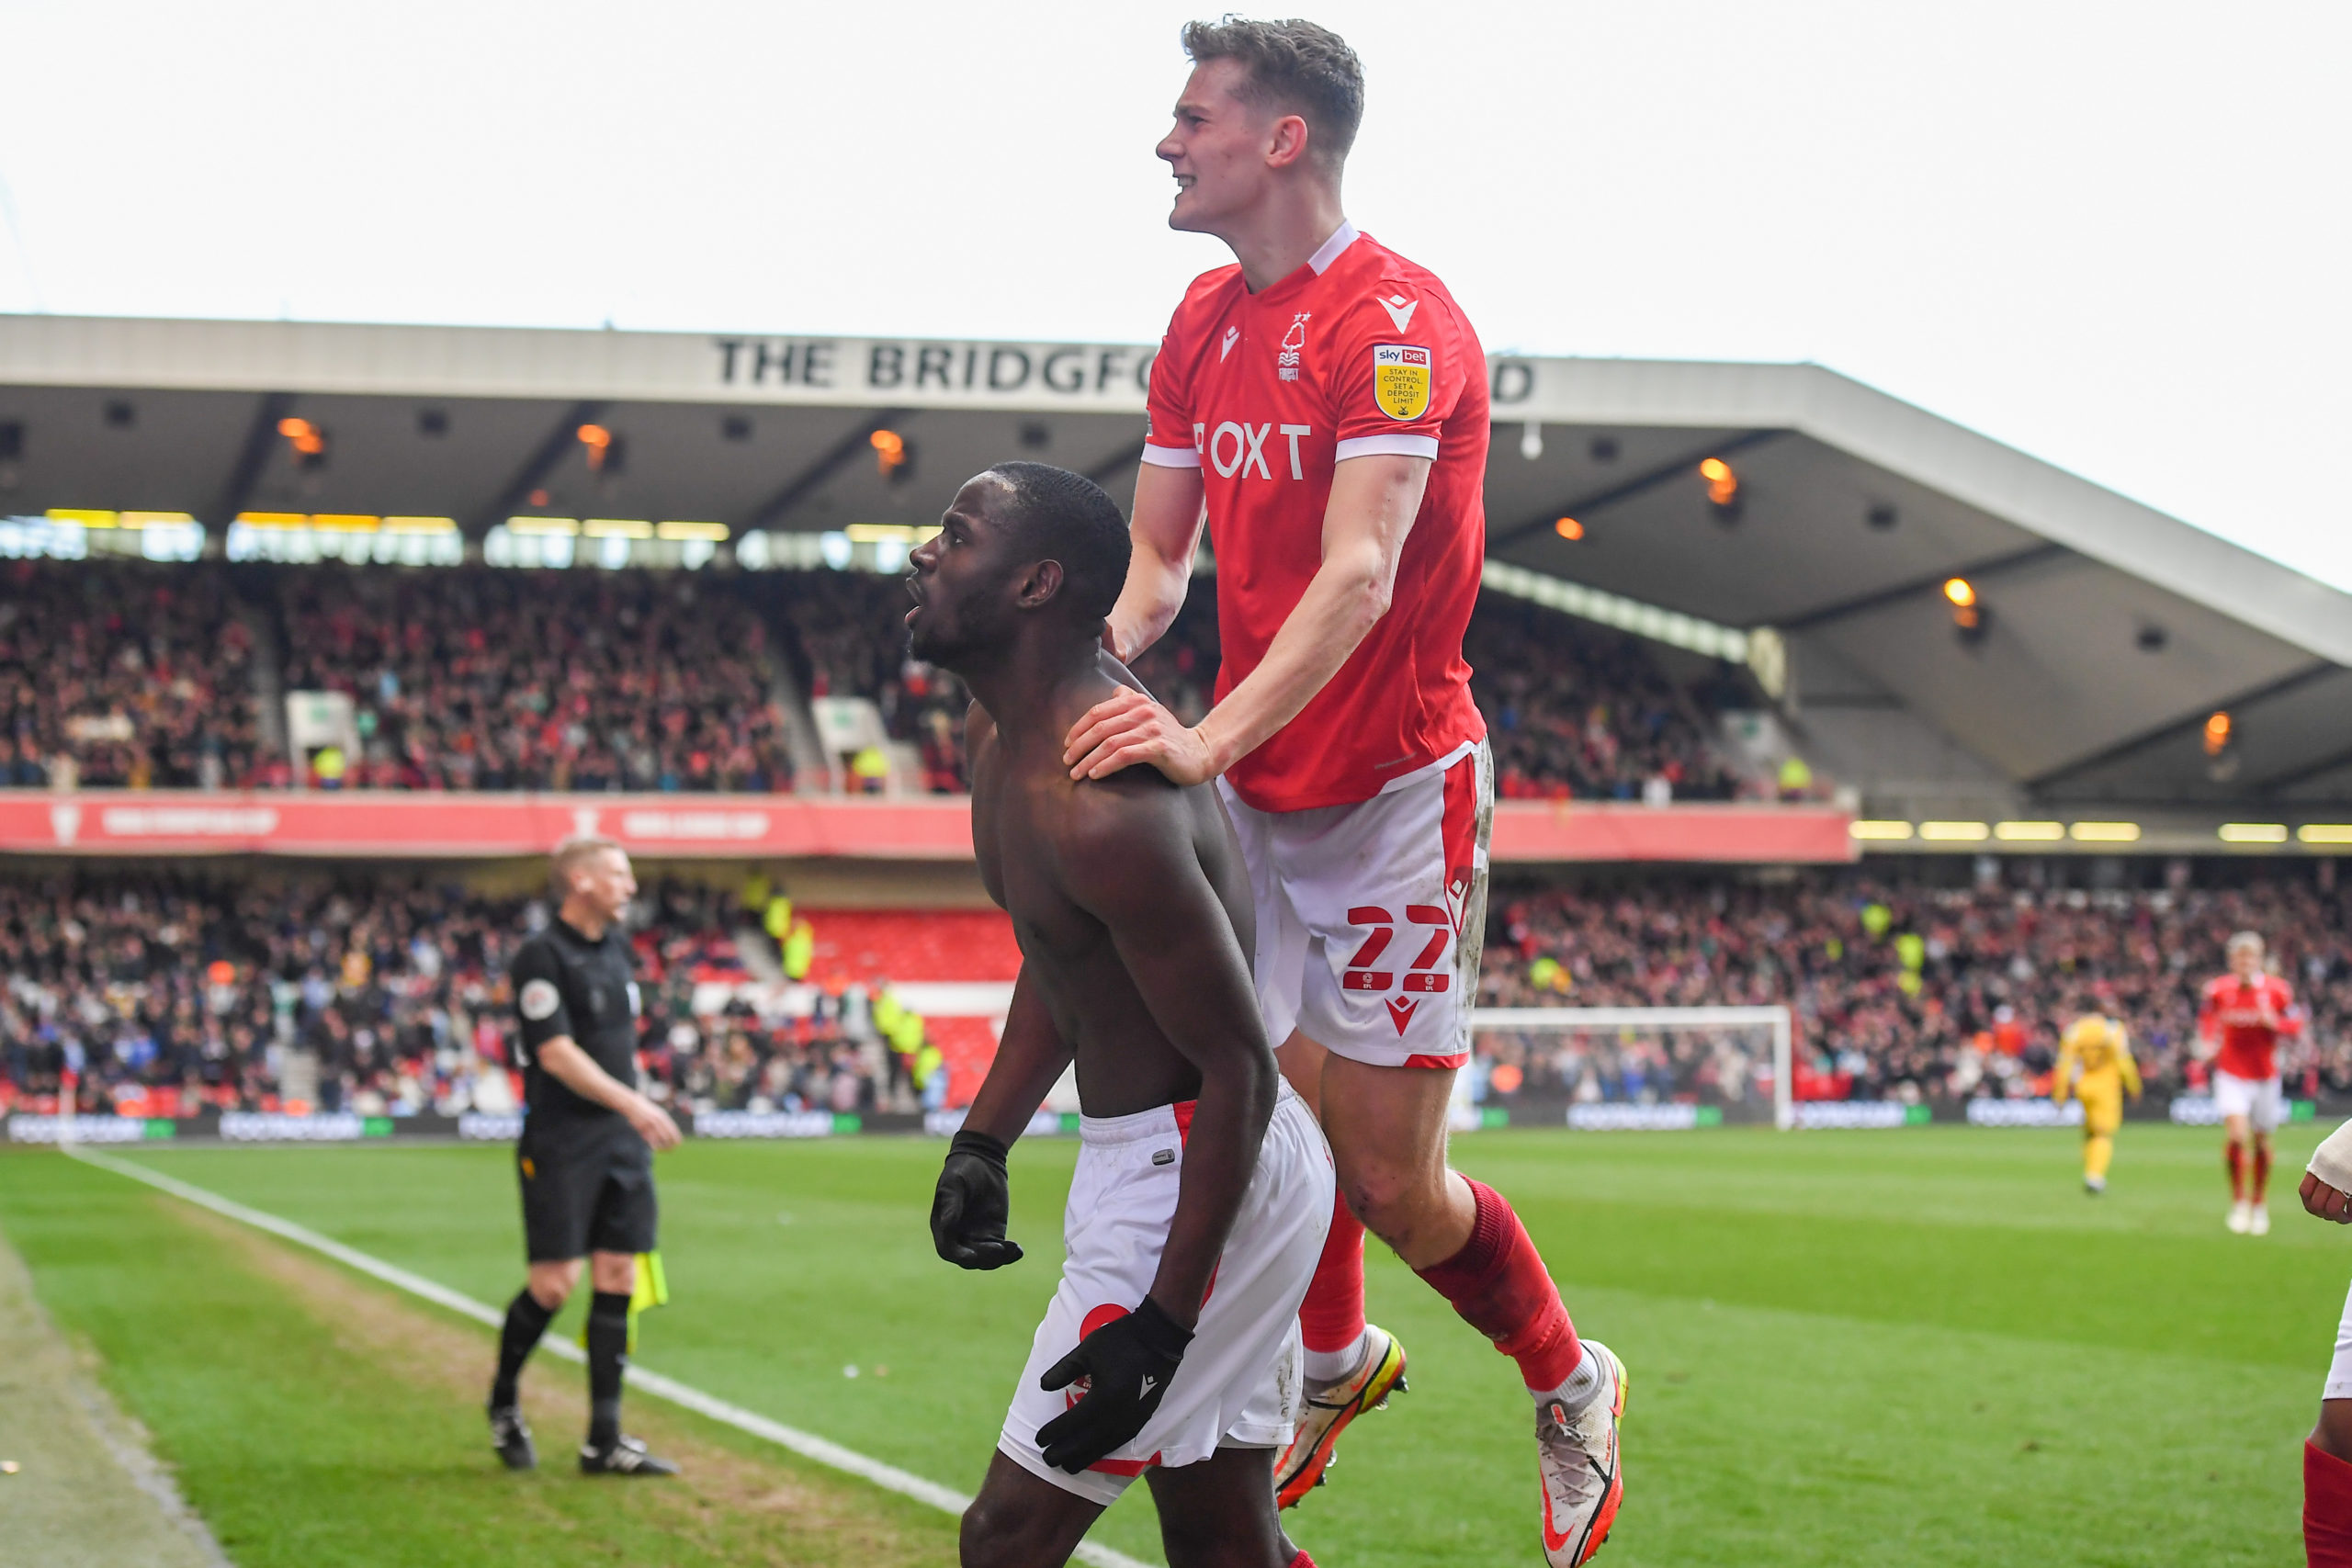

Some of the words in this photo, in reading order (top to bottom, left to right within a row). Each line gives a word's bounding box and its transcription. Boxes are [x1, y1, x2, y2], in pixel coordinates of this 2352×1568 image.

[715, 340, 837, 387] THE
[1379, 349, 1400, 362] sky
[1404, 350, 1425, 362] bet
[1387, 389, 1419, 398] DEPOSIT
[1342, 904, 1450, 993] 22
